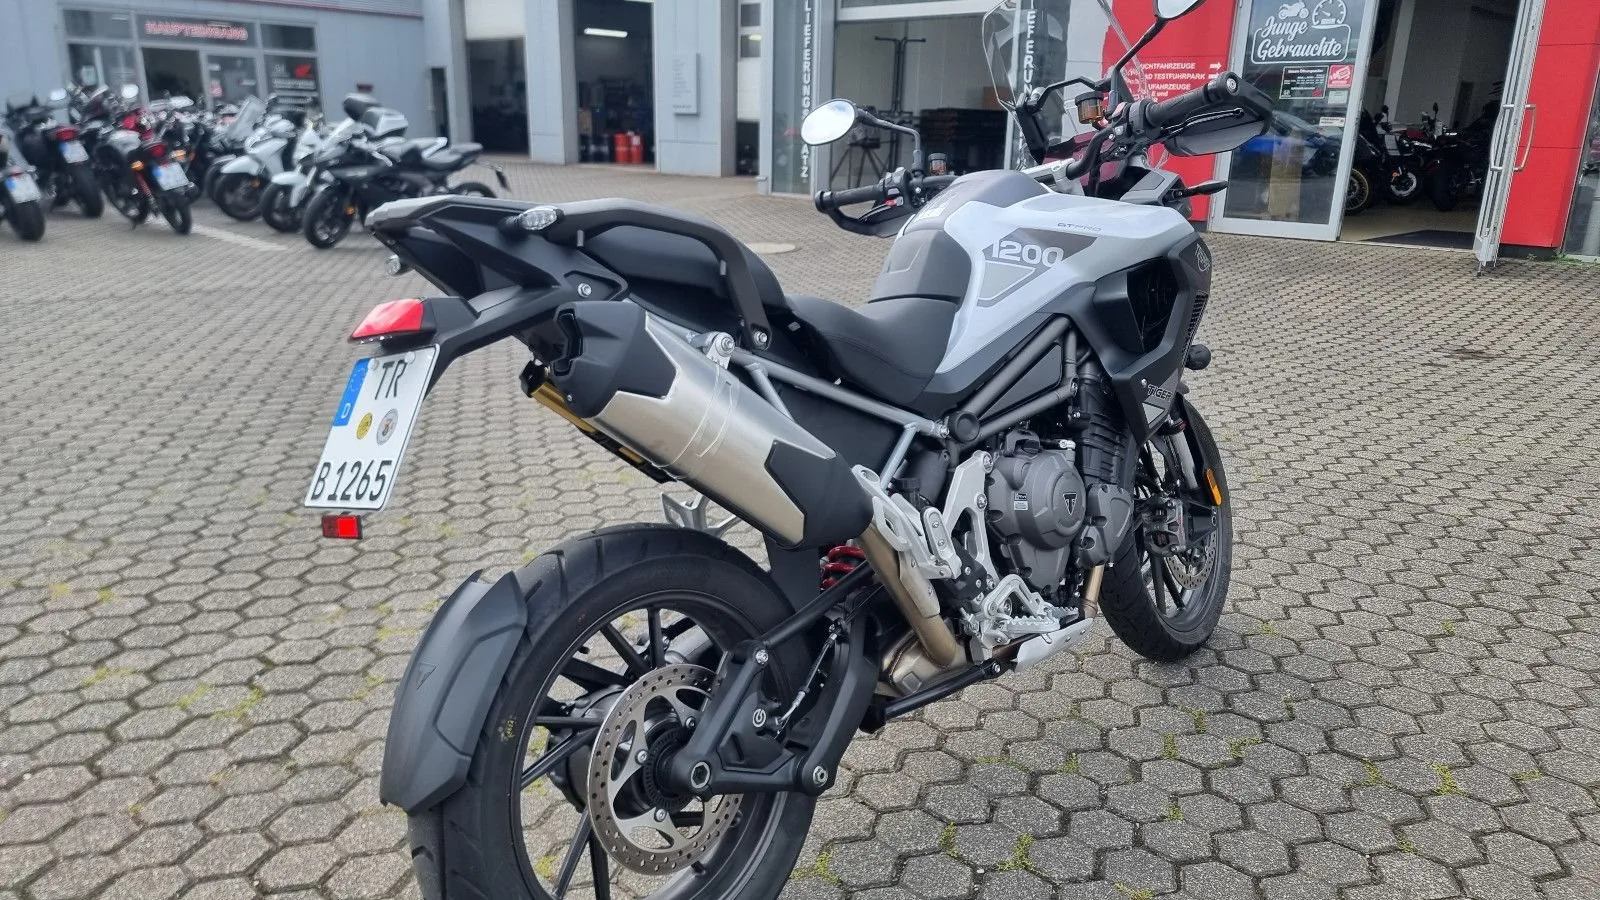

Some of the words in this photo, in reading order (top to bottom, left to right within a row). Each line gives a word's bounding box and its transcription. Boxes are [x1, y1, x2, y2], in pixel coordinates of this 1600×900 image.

[1261, 16, 1308, 41] Junge
[1257, 37, 1342, 60] Gebrauchte
[1140, 62, 1196, 70] UCHTFAHRZEUGE
[801, 0, 811, 178] LIEFERUNGSATZ
[991, 239, 1065, 268] 1200
[374, 359, 408, 401] TR
[1147, 384, 1174, 401] TIGER
[341, 402, 352, 419] D
